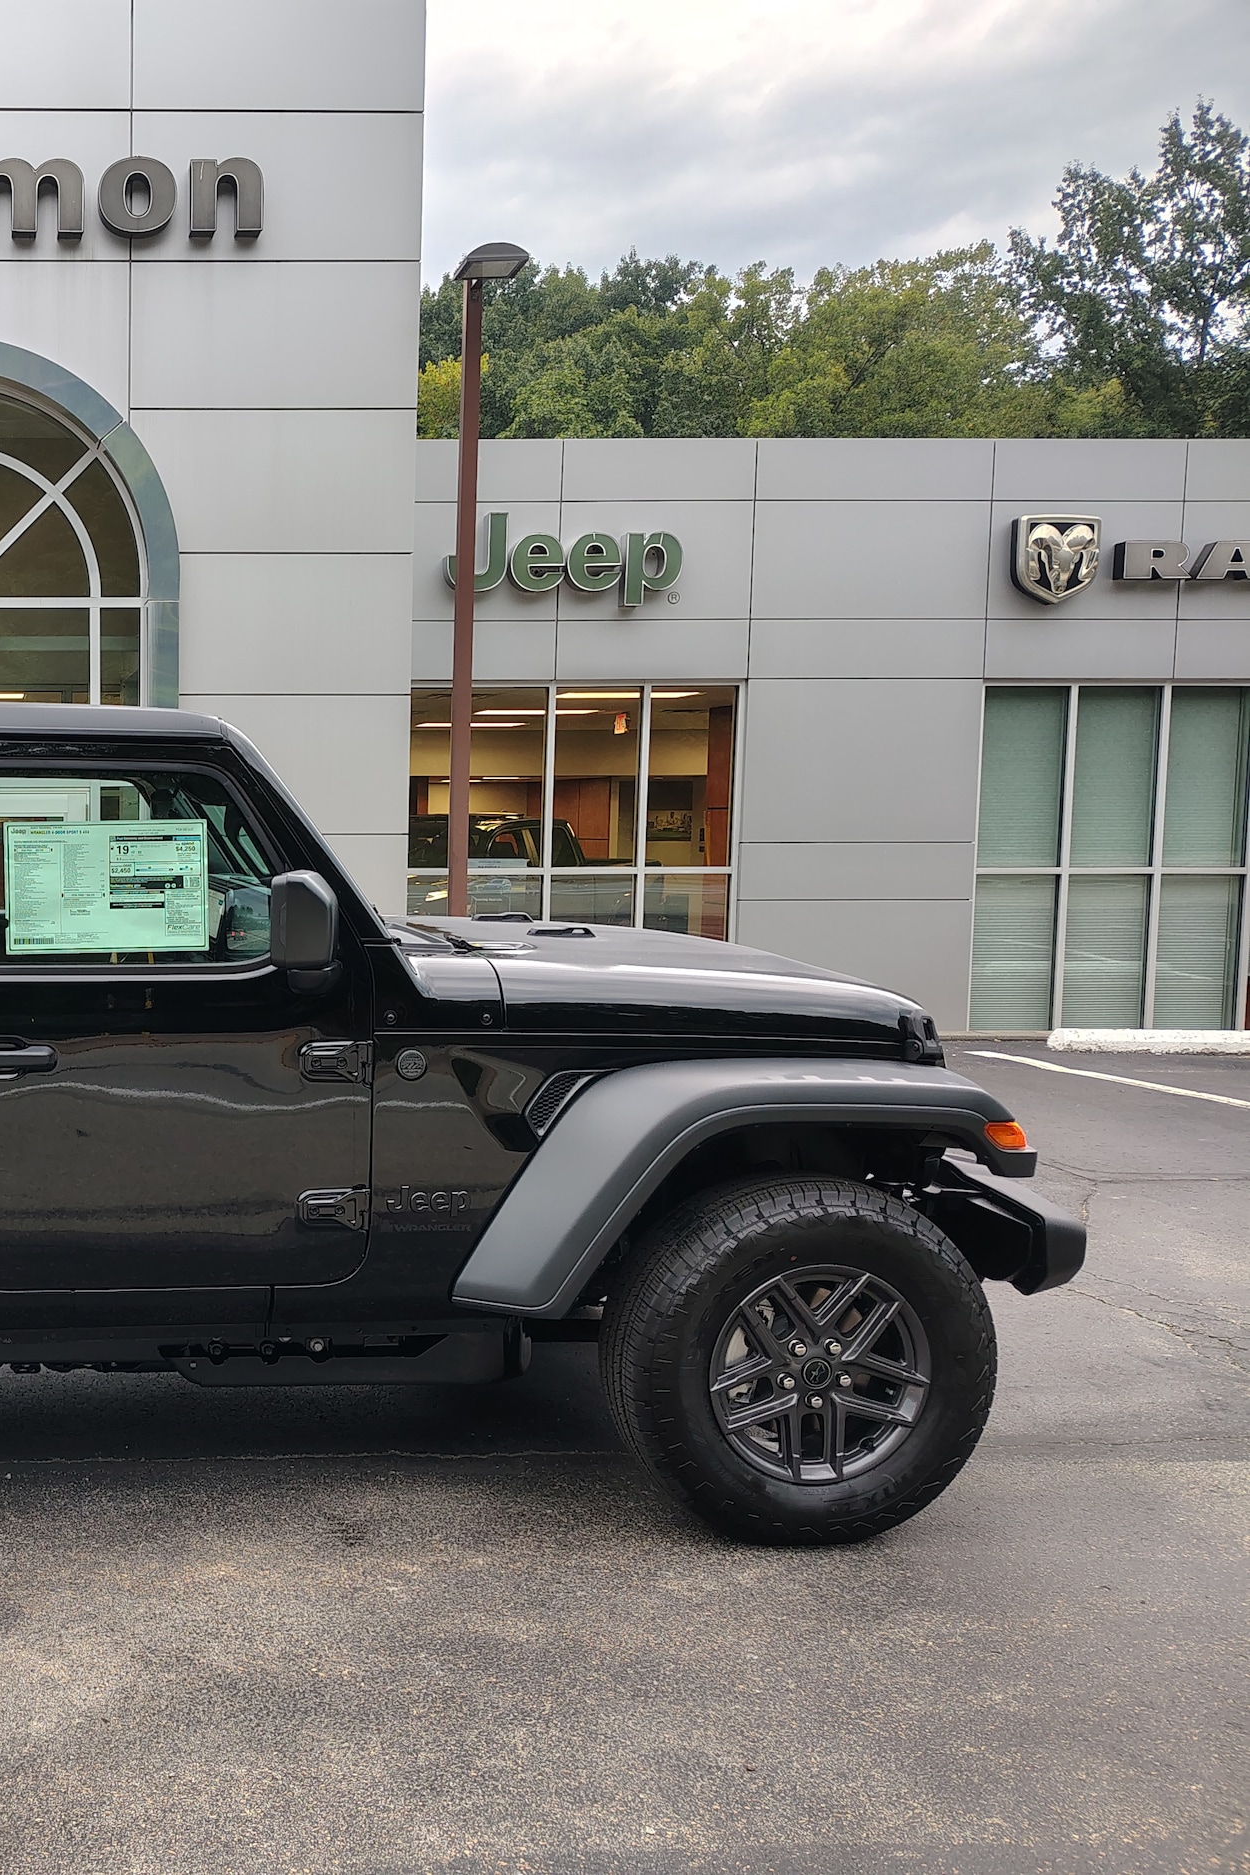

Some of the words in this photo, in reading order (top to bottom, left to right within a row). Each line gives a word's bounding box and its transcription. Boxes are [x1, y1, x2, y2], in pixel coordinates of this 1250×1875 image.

[442, 511, 684, 608] Jeep
[116, 845, 130, 855] 19
[385, 1184, 472, 1219] Jeep
[392, 1223, 472, 1233] WRANGLER
